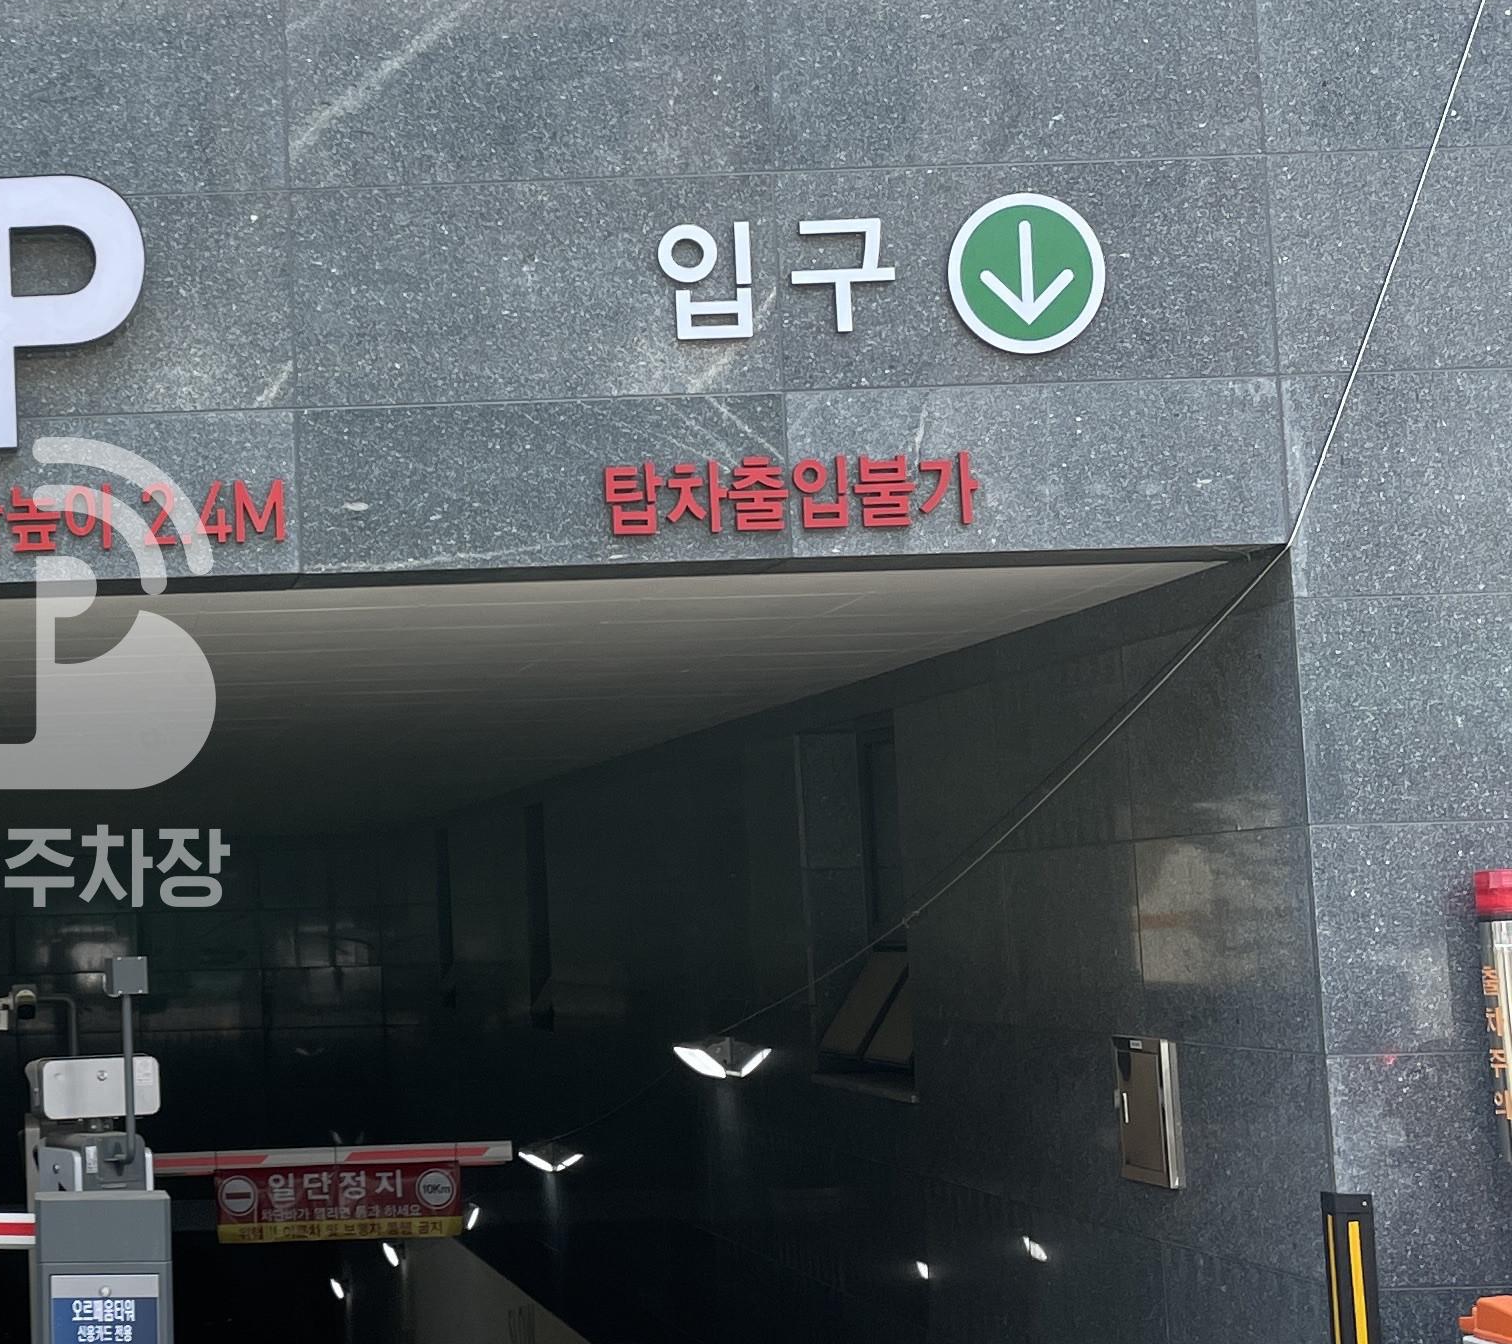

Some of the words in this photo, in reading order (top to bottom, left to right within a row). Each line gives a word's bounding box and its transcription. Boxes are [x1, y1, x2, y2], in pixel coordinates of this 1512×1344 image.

[657, 217, 896, 340] 입구
[142, 478, 287, 547] 2.4M
[604, 450, 982, 537] 탑차출입불가
[77, 1324, 112, 1342] 신용카드
[114, 1324, 133, 1342] 전용
